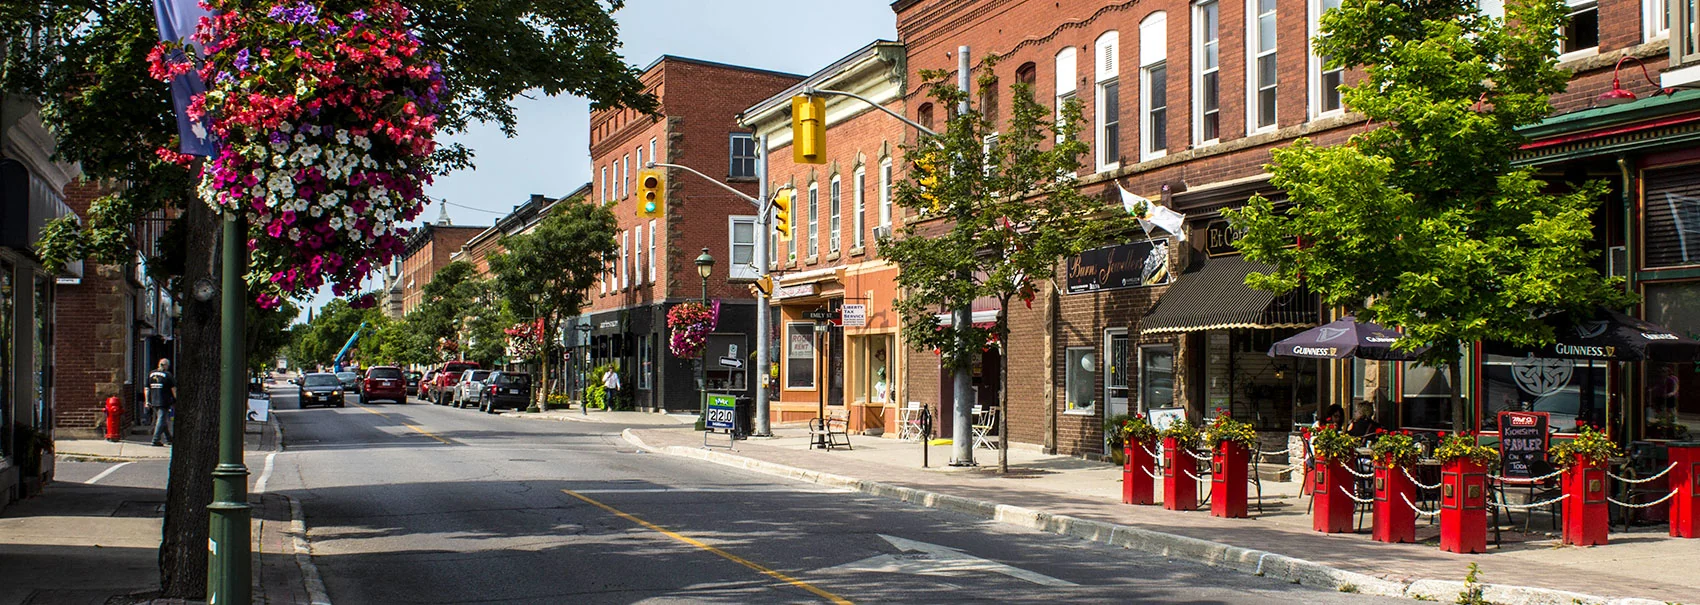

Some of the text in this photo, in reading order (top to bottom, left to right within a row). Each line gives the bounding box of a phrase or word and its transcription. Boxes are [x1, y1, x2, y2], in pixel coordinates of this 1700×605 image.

[1210, 228, 1223, 248] Et
[1099, 248, 1143, 285] Jewellers
[1293, 345, 1328, 356] GUINNESS
[1555, 343, 1603, 357] GUINNESS
